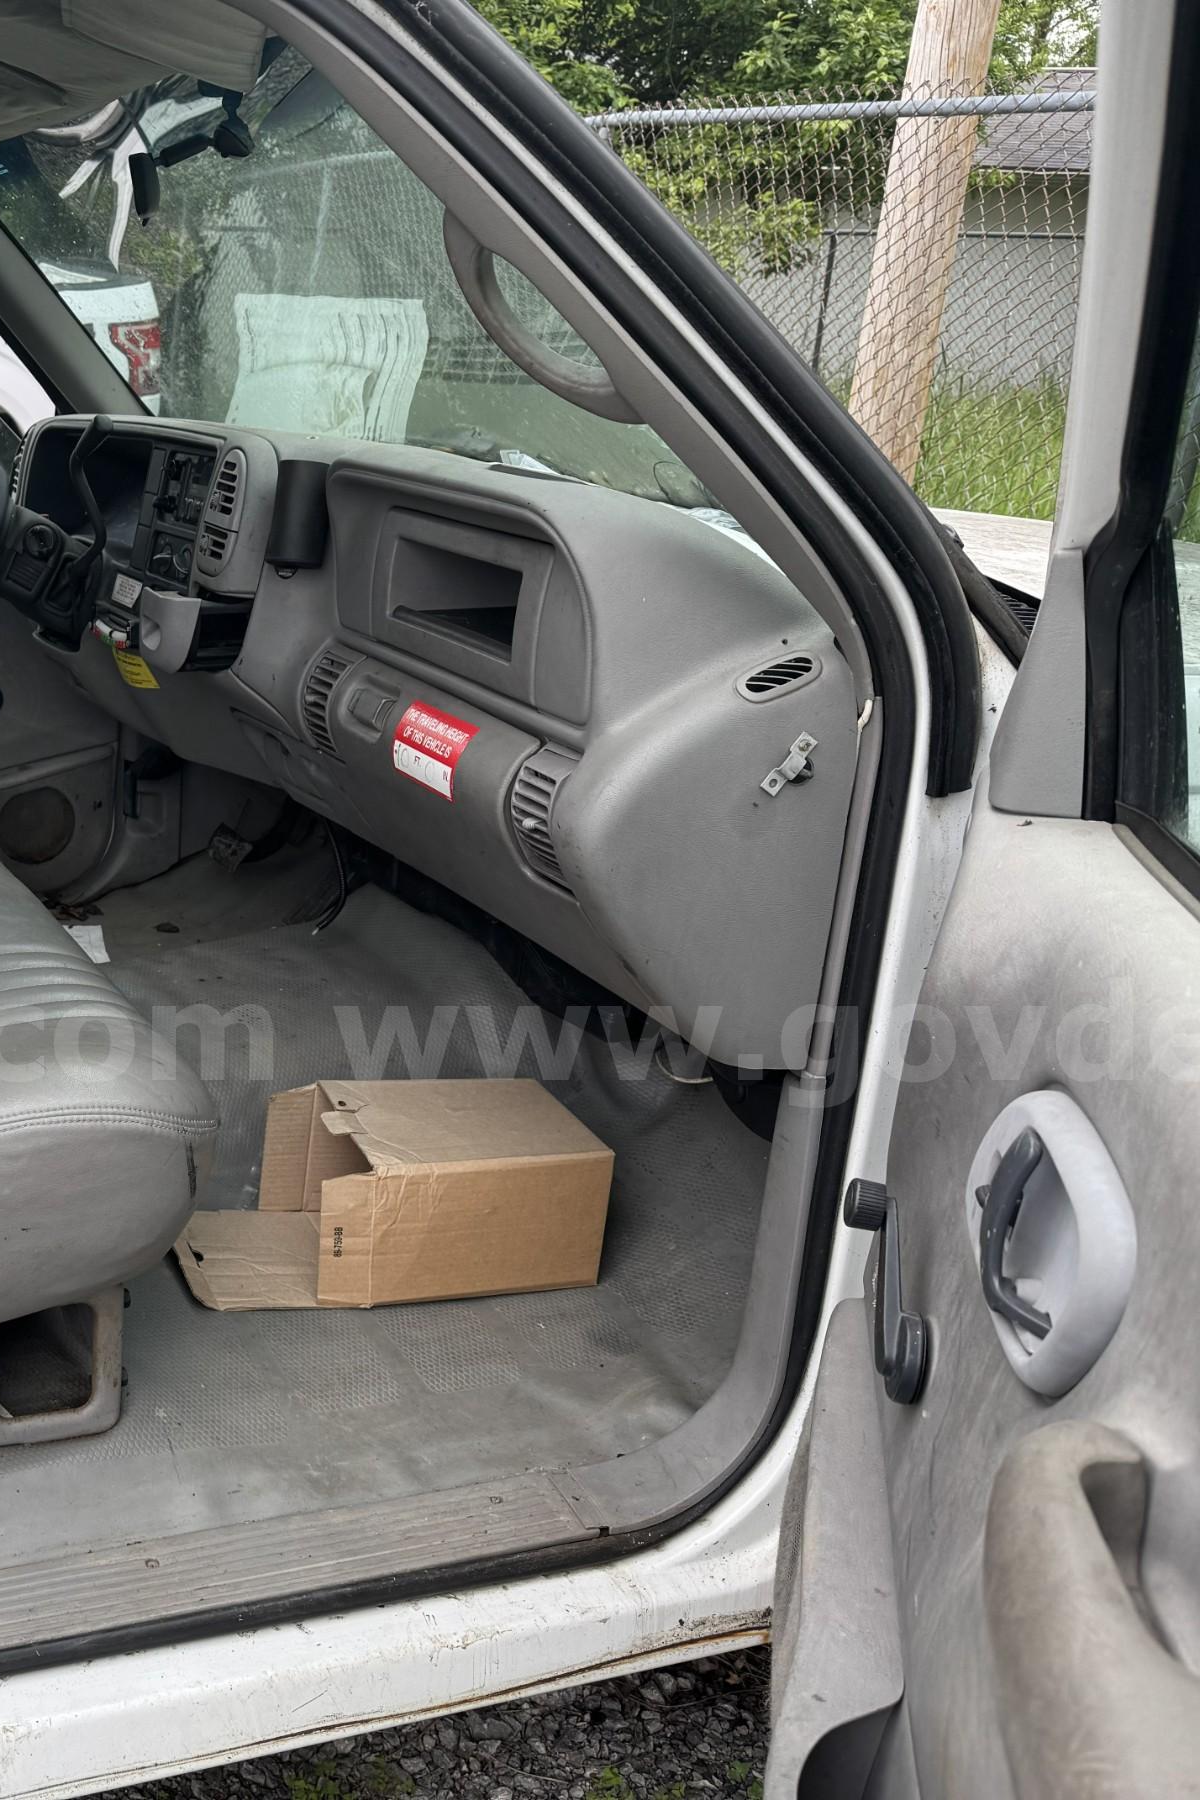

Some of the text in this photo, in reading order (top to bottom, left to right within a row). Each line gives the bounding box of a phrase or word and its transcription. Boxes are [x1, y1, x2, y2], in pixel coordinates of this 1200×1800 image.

[403, 725, 453, 759] OF THIS VEHICLE IS
[445, 727, 470, 745] HEIGHT
